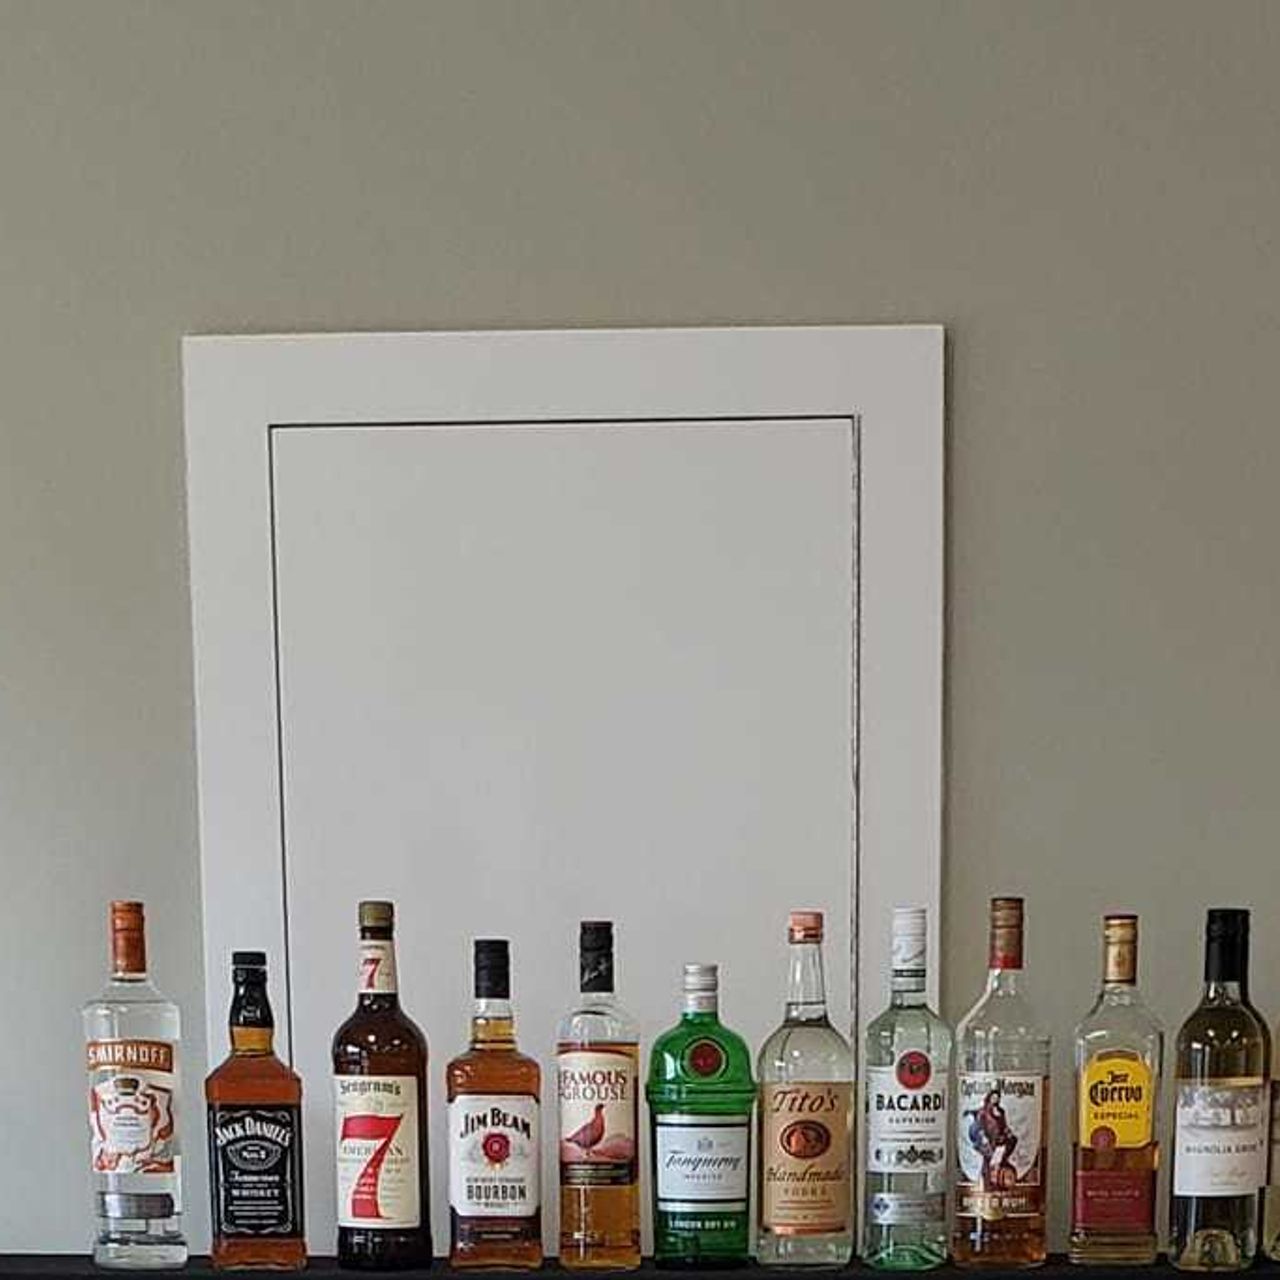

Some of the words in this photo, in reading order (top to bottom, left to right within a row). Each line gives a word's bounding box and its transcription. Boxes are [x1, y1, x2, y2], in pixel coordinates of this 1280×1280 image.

[88, 1043, 168, 1065] SMIRNOFF
[563, 1070, 627, 1085] FAMOUS
[771, 1088, 839, 1113] Tito's
[1090, 1081, 1142, 1107] Cuervo
[215, 1123, 245, 1146] JACK
[460, 1113, 487, 1138] JIM
[491, 1107, 531, 1140] BEAM
[341, 1113, 405, 1219] 7
[467, 1185, 526, 1200] BOURBON
